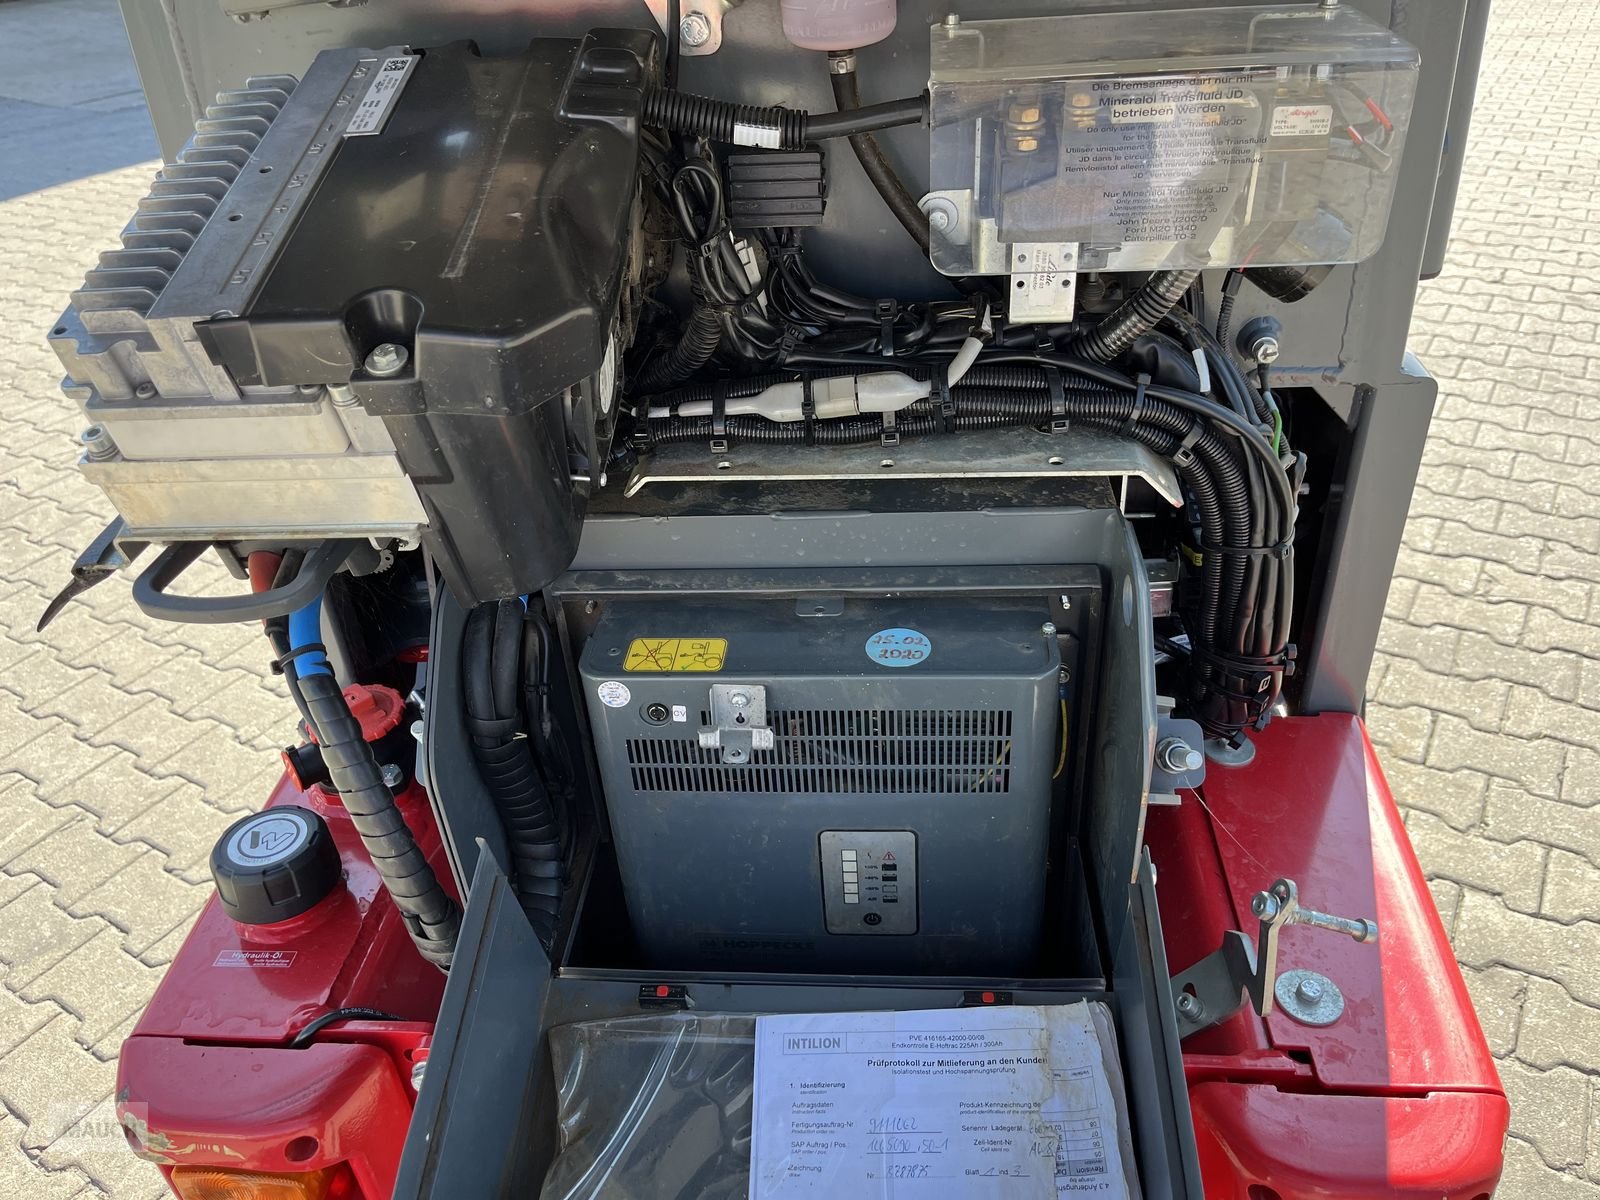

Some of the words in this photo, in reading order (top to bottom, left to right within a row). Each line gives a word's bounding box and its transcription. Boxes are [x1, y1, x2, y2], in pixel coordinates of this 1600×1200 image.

[1092, 83, 1109, 91] Die
[1113, 79, 1186, 91] Bremsanlage
[1236, 75, 1254, 83] mit
[1226, 90, 1243, 100] JD
[1113, 106, 1174, 118] betrieben
[1066, 146, 1094, 154] Utiliser
[1096, 144, 1145, 153] uniquement
[1226, 137, 1266, 145] Transfluid
[1124, 234, 1170, 242] Caterpillar
[879, 648, 924, 660] 2020
[788, 1038, 840, 1050] INTILION
[984, 1040, 1002, 1048] 300Ah
[868, 1059, 920, 1068] Prüfprotokoll
[938, 1059, 985, 1068] Mitlieferung
[1016, 1056, 1048, 1064] Kunden
[892, 1068, 931, 1076] Isolationstest
[945, 1066, 1016, 1076] Hochspannungsprüfung
[960, 1102, 1032, 1110] Produkt-Kennzeichnung
[1091, 1130, 1098, 1138] 07
[1092, 1140, 1100, 1148] 06
[1094, 1150, 1102, 1158] 05
[788, 1164, 822, 1172] Zeichnung
[1076, 1166, 1104, 1174] Revision
